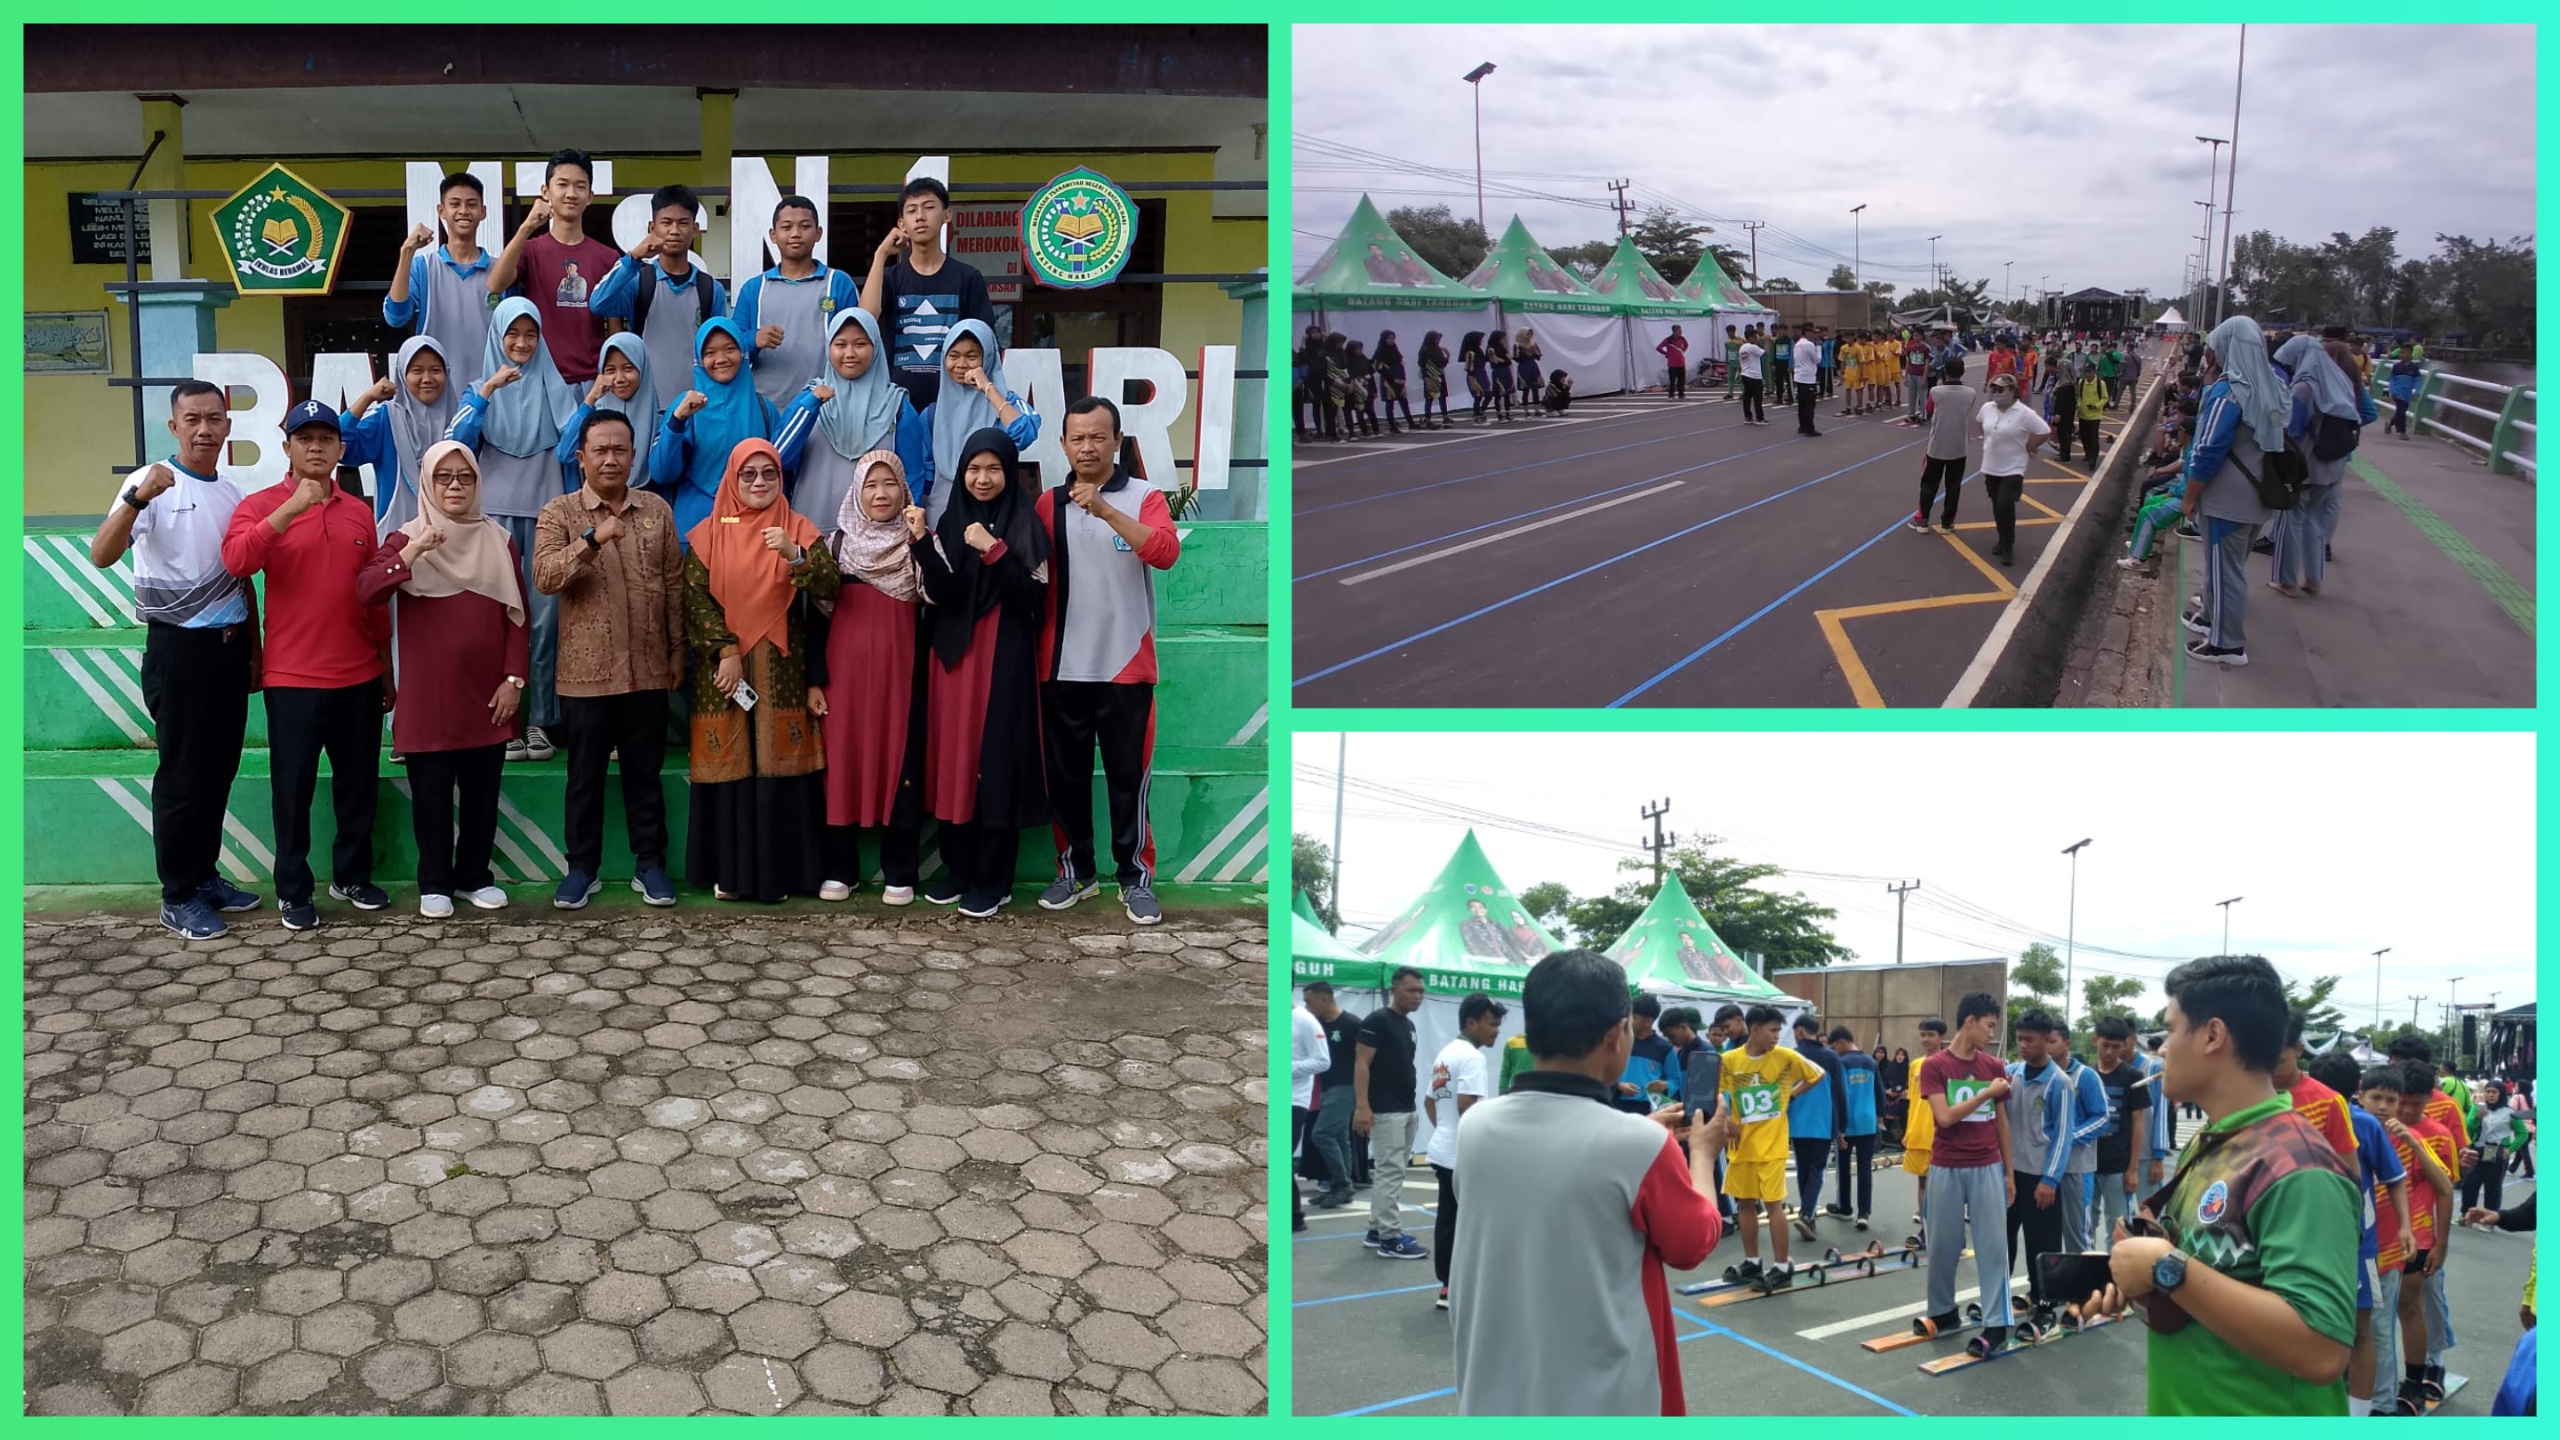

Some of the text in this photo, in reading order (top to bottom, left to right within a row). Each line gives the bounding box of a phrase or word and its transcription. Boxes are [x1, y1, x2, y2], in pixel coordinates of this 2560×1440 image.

[956, 210, 1018, 227] DILARANG
[957, 236, 1019, 253] MEROKOK
[254, 259, 310, 276] IKHLAS BERAMAL
[1007, 262, 1017, 274] DI
[1035, 251, 1063, 277] BATANG
[1068, 272, 1091, 280] HARI
[1100, 249, 1122, 273] JAMBI
[1429, 973, 1491, 990] BATANG
[1741, 1089, 1772, 1115] 03
